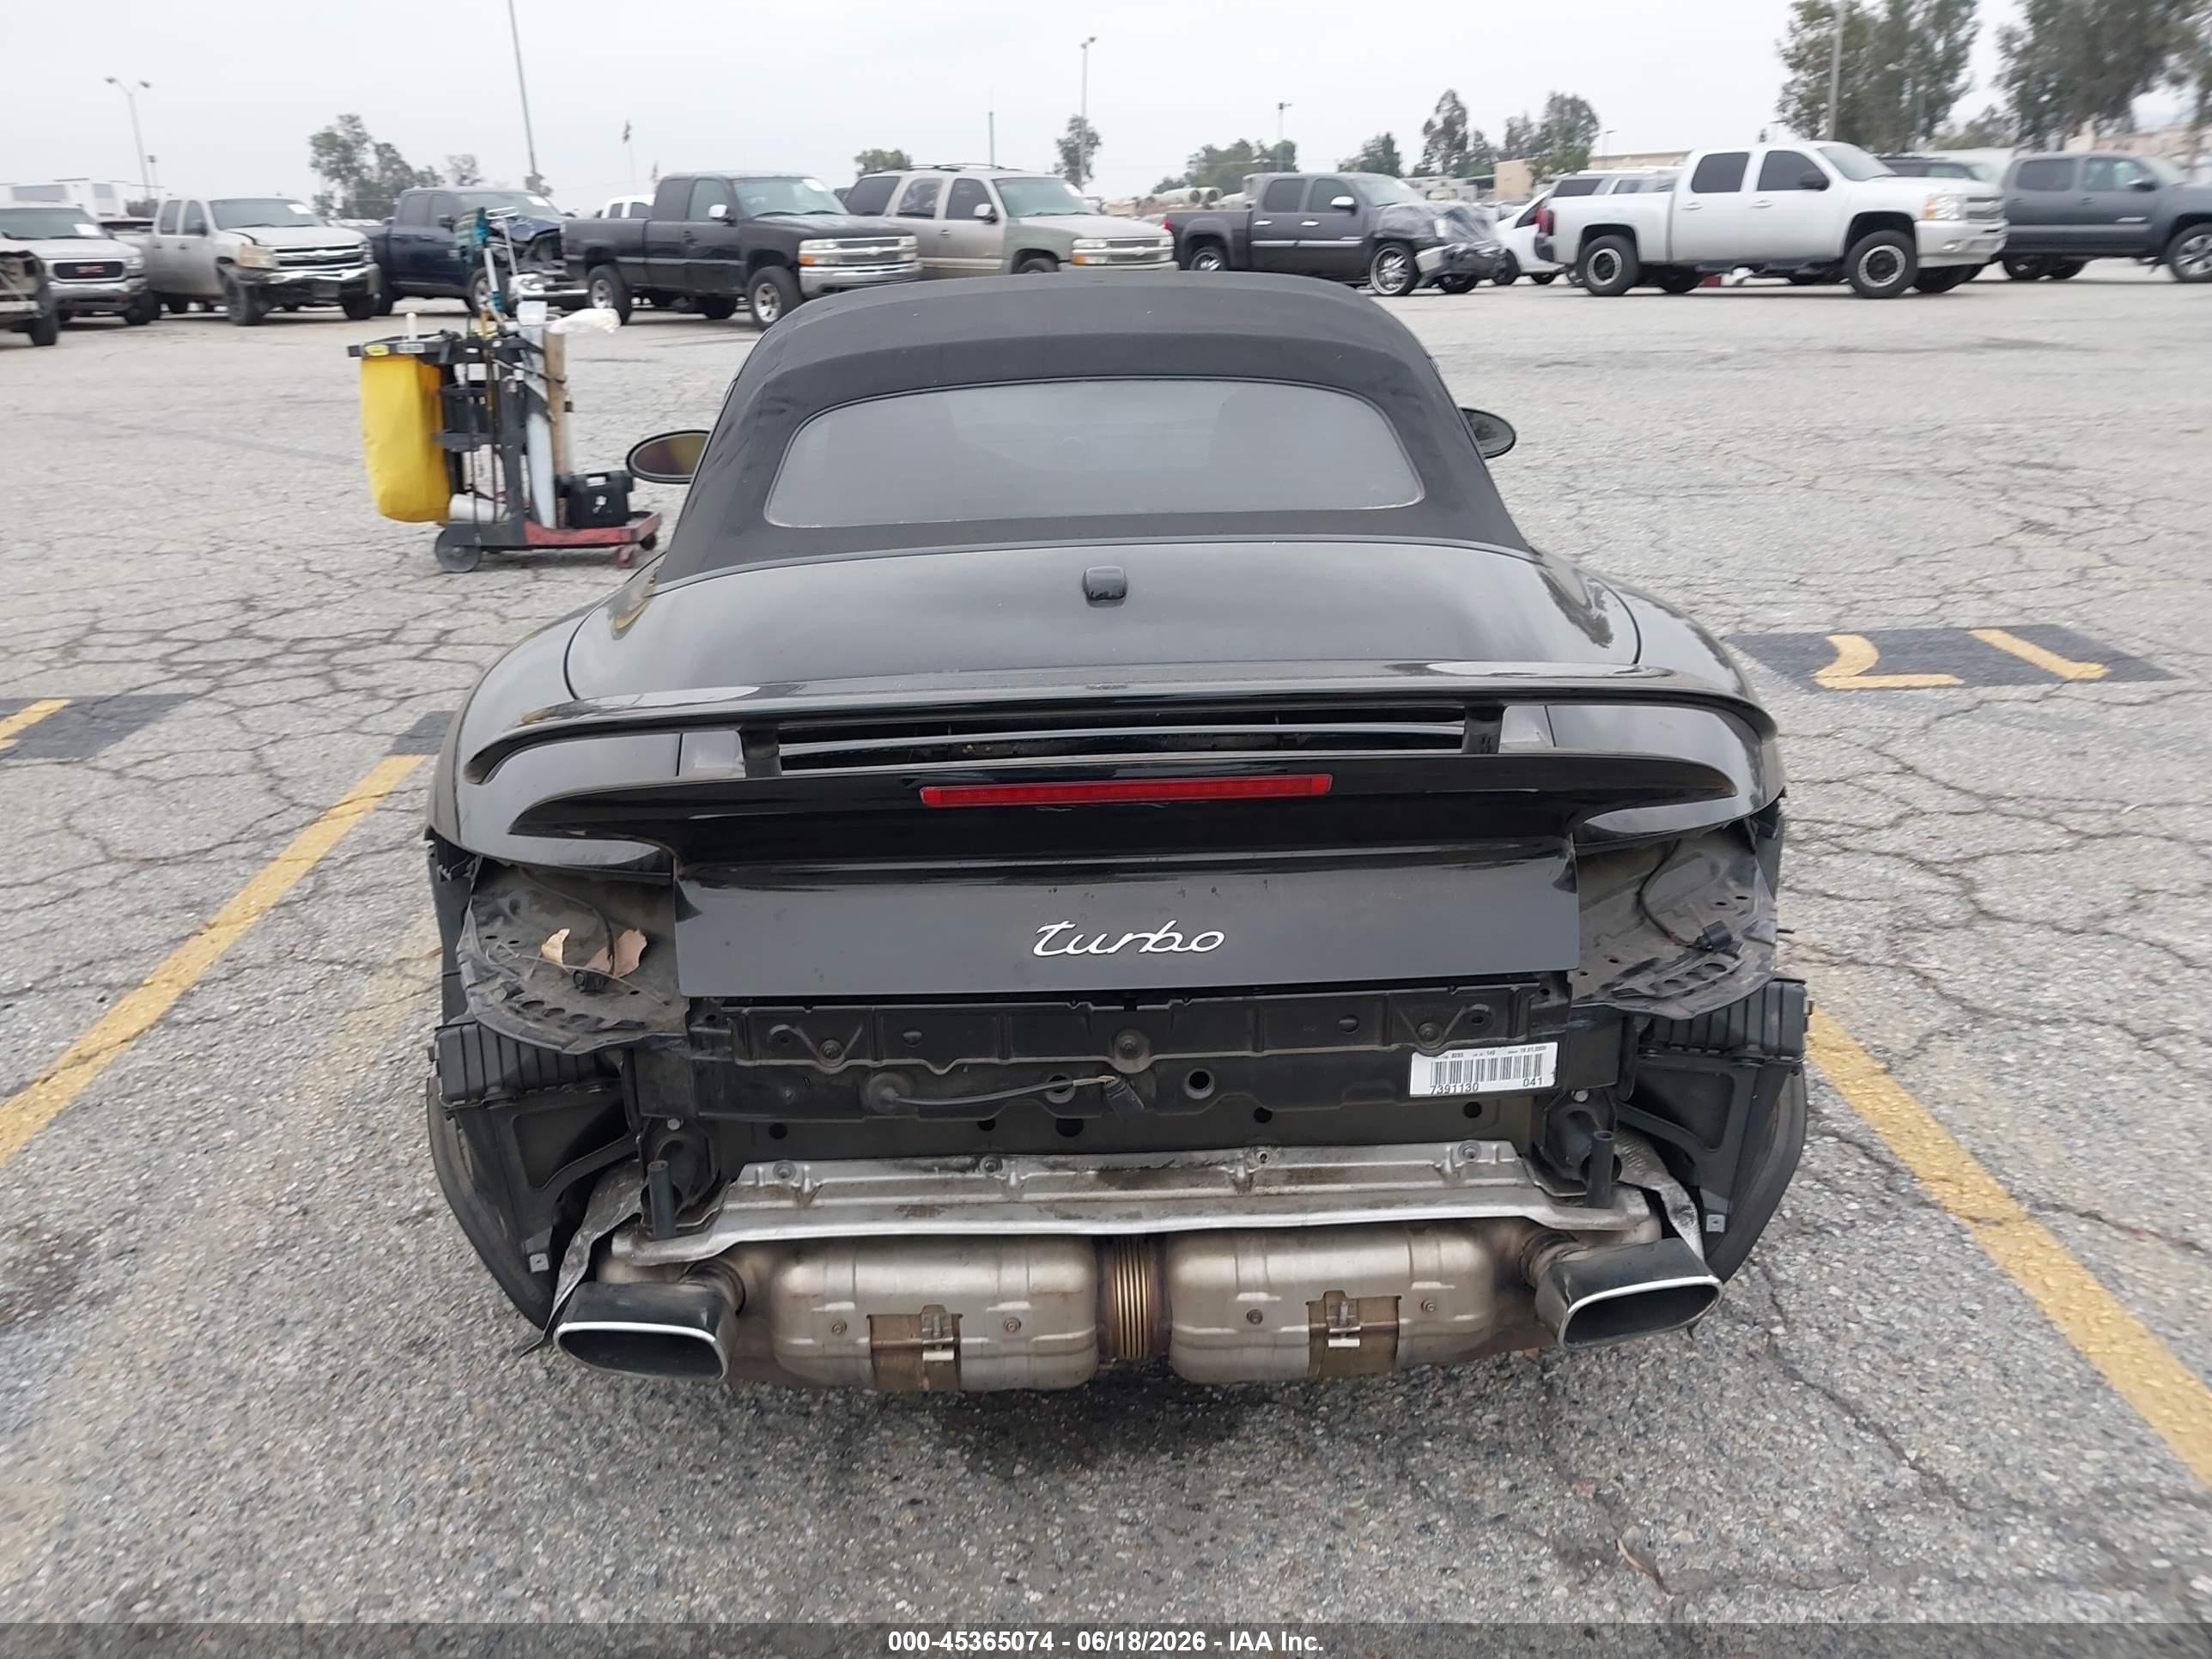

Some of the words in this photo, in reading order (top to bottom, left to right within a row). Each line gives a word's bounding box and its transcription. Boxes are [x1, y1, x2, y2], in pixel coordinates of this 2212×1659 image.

[1033, 920, 1225, 957] turbo
[1430, 1083, 1480, 1096] 7391130
[1522, 1078, 1543, 1088] 041
